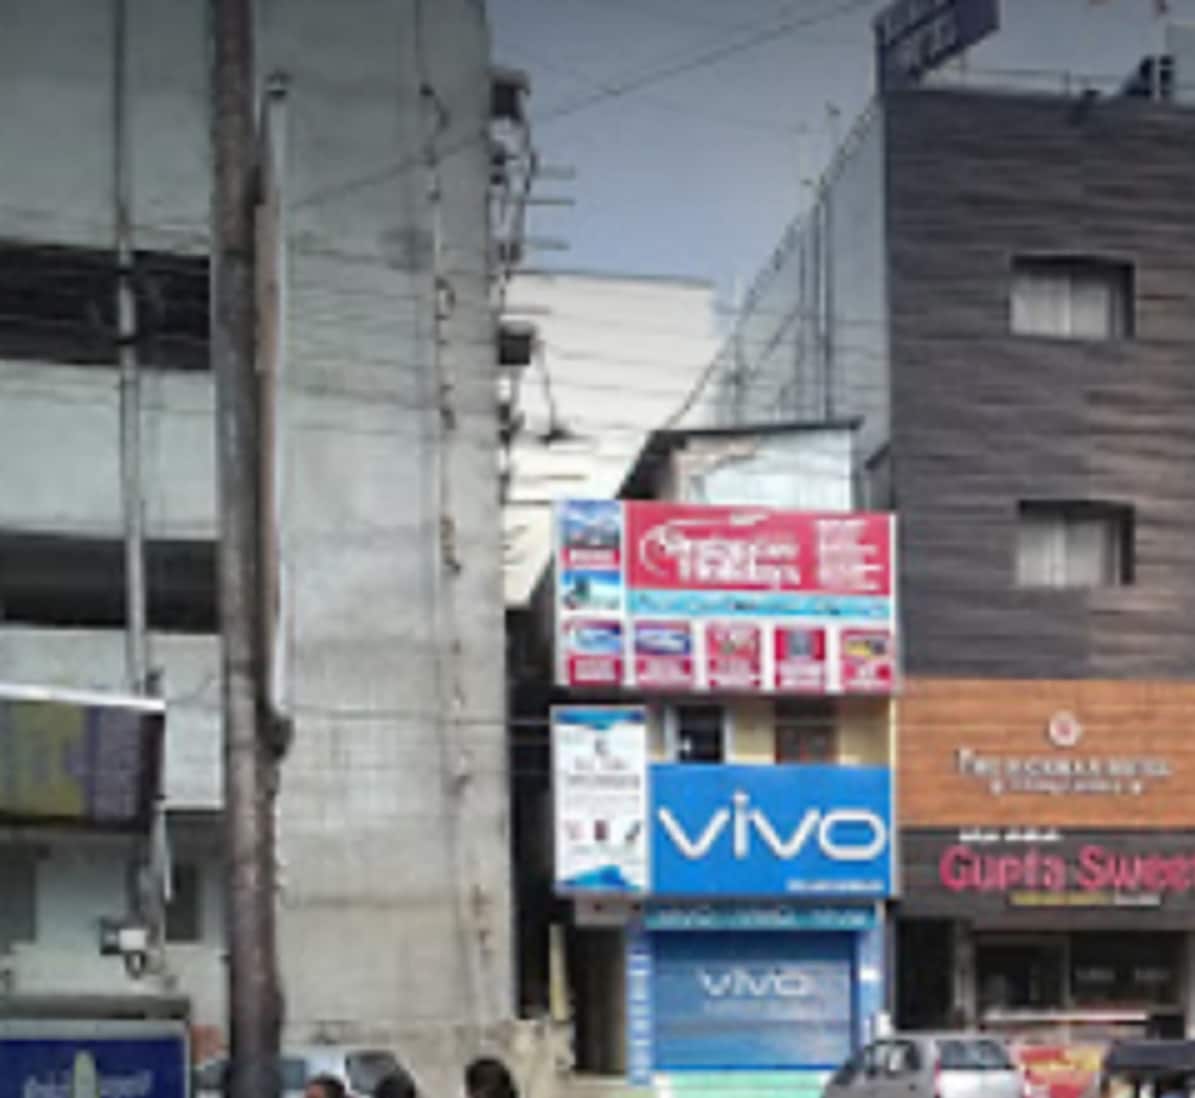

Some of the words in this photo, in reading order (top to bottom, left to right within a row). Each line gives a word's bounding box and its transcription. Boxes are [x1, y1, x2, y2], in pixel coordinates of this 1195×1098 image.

[655, 789, 888, 862] vivo
[938, 844, 1066, 893] Gupta
[697, 965, 815, 997] vivo
